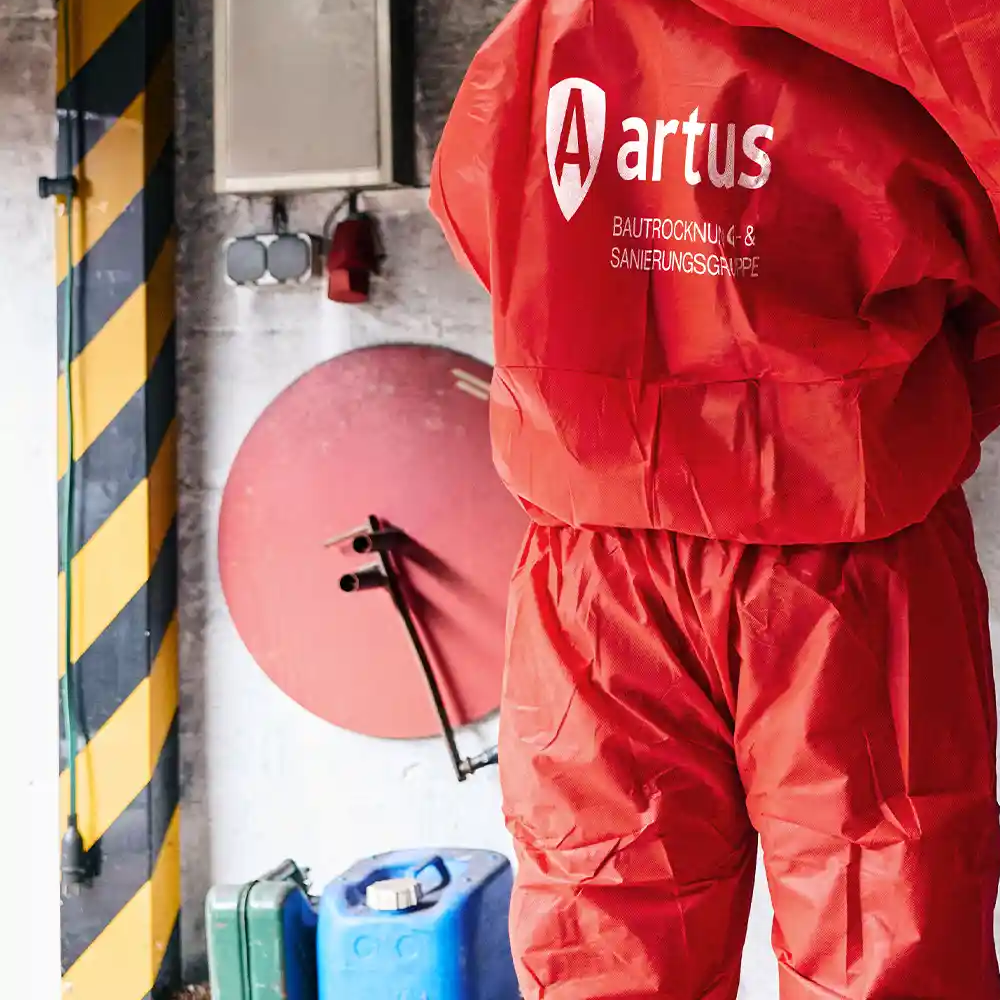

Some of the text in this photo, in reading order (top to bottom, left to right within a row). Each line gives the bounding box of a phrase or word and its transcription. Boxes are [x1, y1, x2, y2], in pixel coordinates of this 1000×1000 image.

[555, 88, 774, 190] A artus
[744, 225, 756, 246] &
